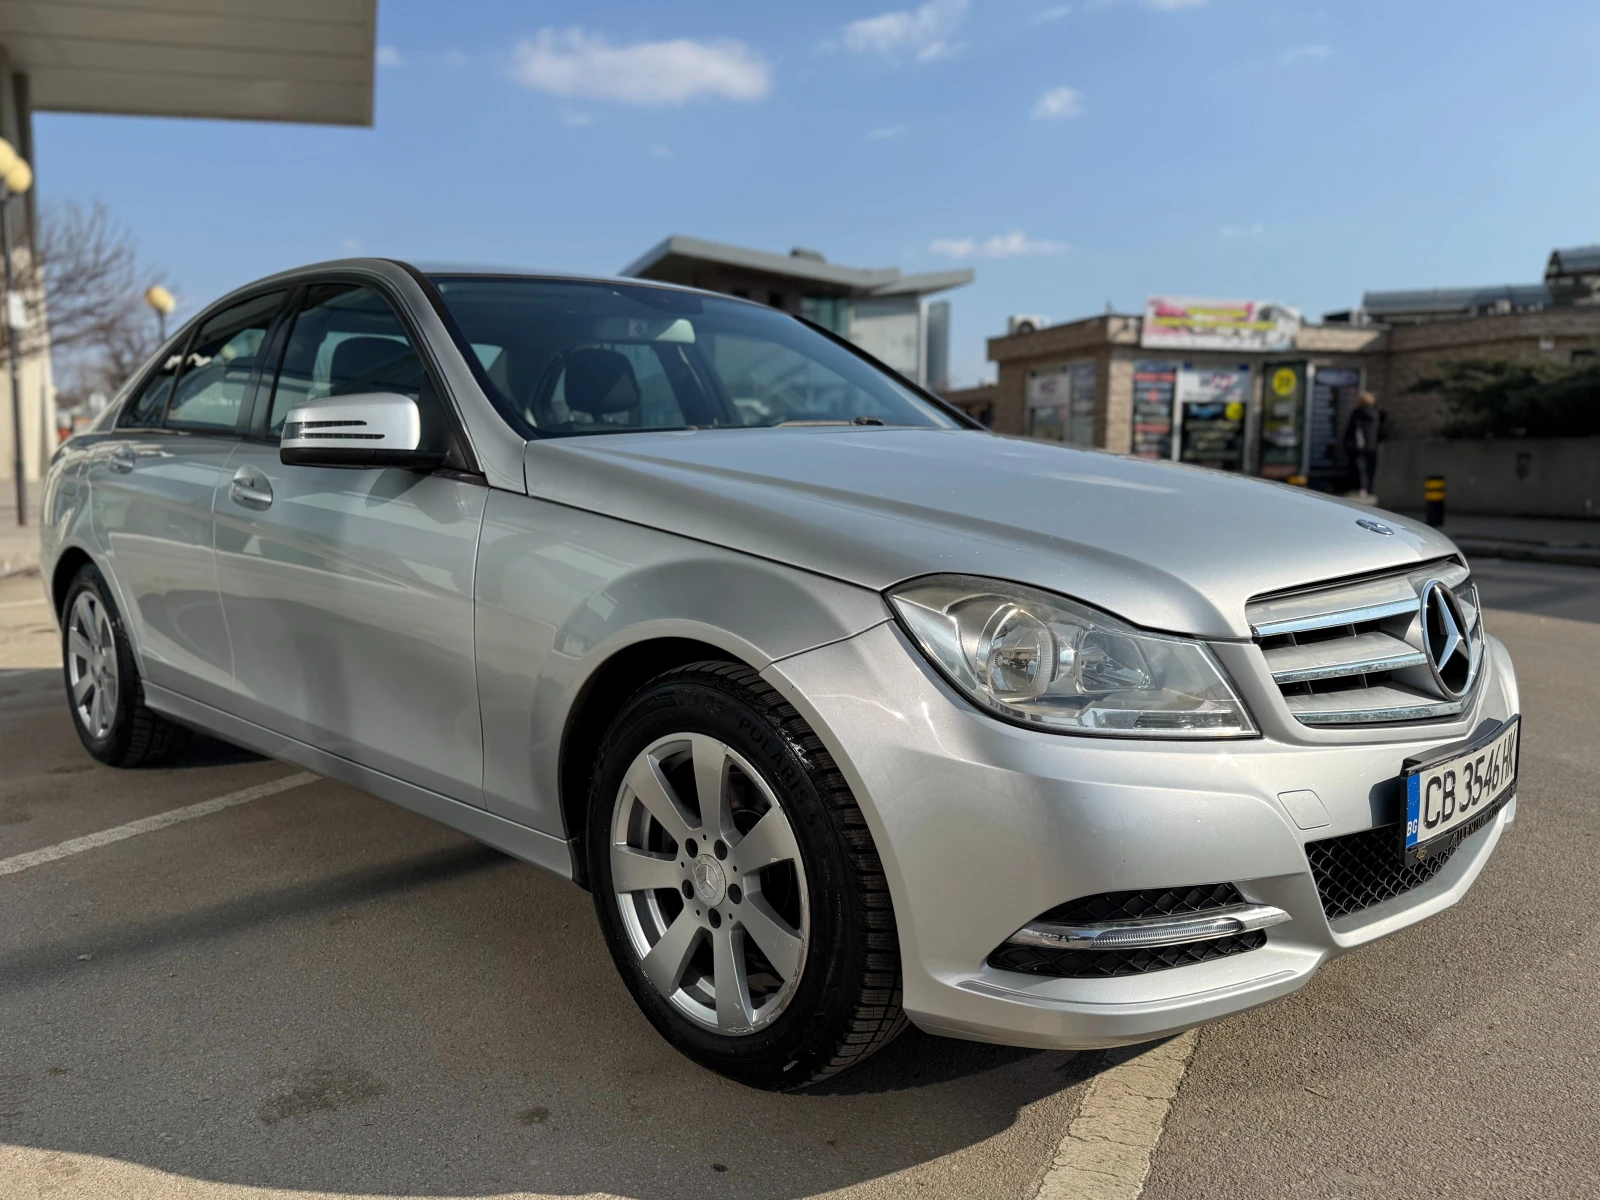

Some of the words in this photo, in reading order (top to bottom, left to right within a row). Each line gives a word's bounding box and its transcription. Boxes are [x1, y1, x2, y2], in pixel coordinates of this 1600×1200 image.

[738, 717, 809, 806] POLARIS
[1423, 769, 1457, 831] CB
[1459, 743, 1502, 813] 3546
[1406, 819, 1418, 837] BG
